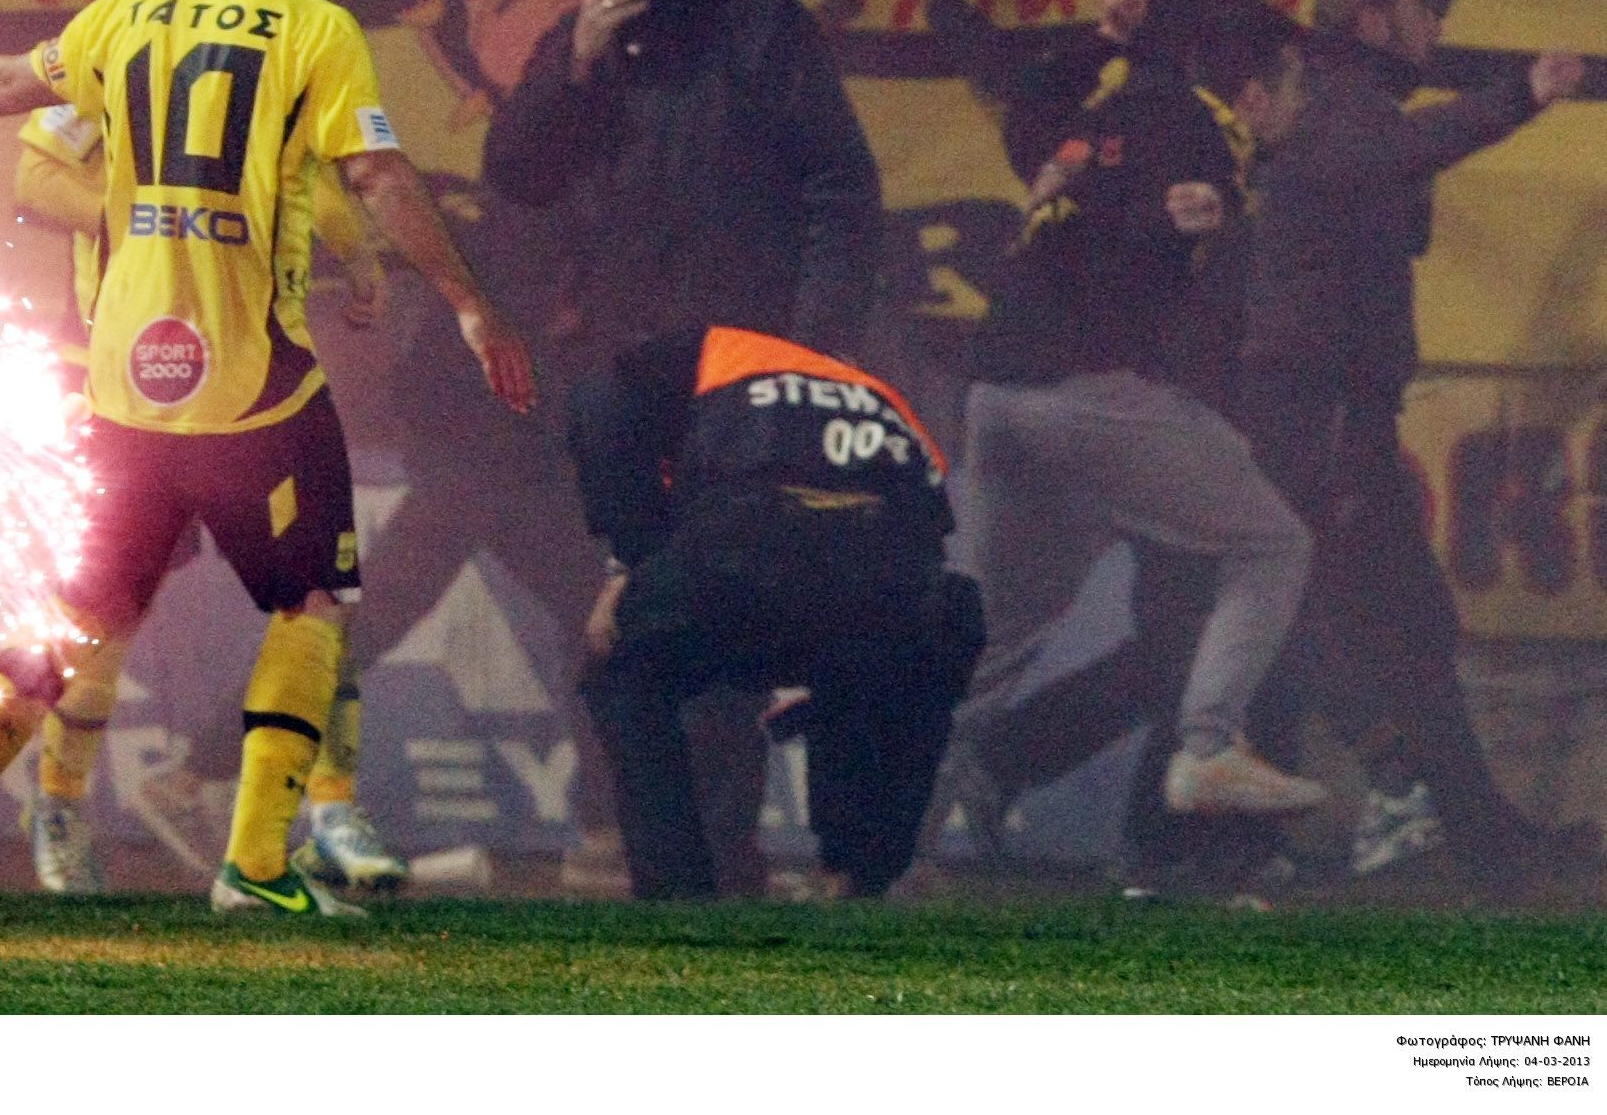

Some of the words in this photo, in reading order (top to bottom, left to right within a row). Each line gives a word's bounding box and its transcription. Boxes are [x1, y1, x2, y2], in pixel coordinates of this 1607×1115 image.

[126, 40, 267, 195] 10
[128, 202, 250, 246] BEKO
[135, 343, 195, 362] SPORT
[138, 363, 193, 380] 2000
